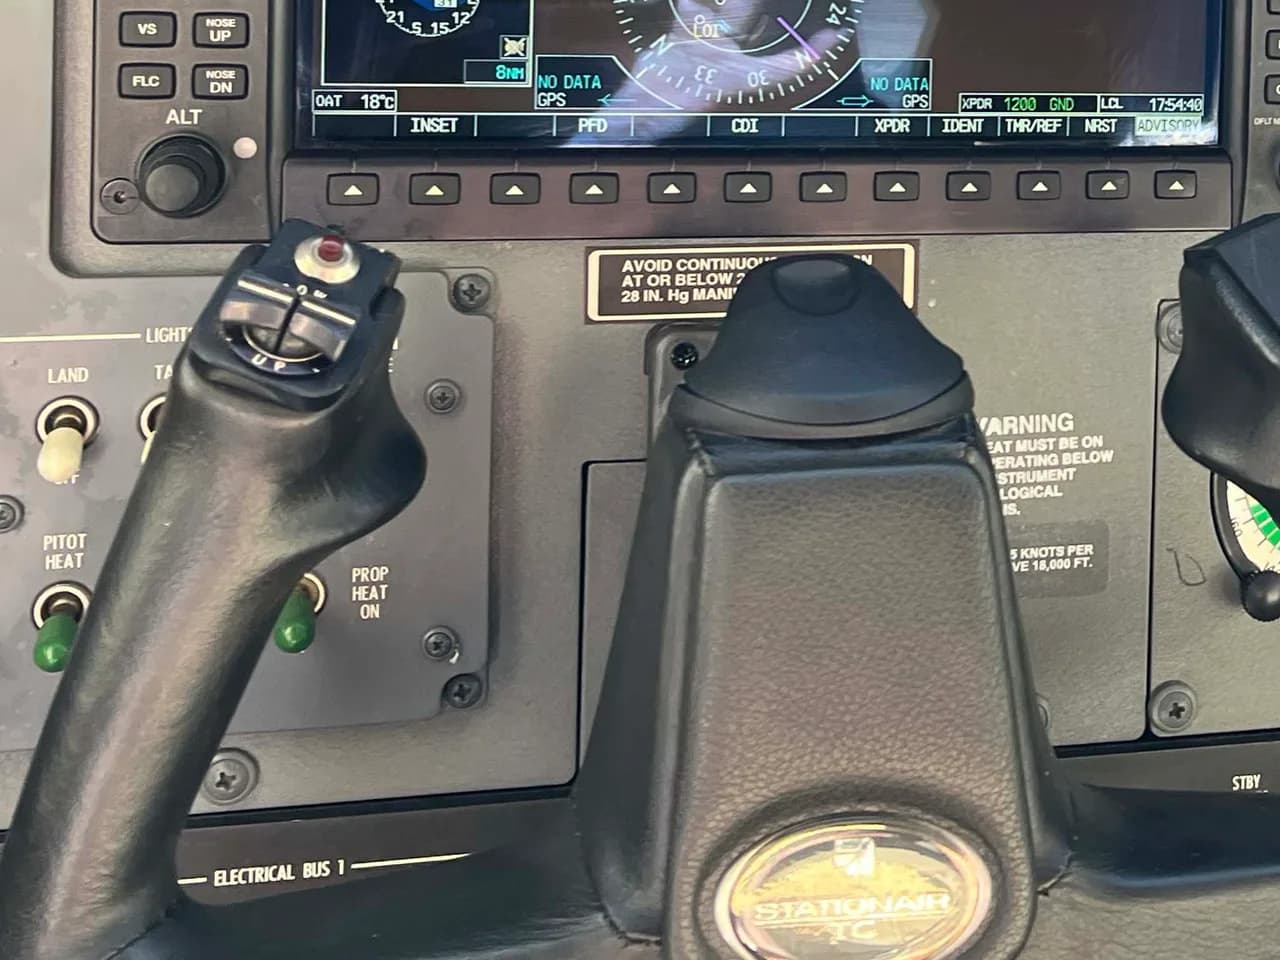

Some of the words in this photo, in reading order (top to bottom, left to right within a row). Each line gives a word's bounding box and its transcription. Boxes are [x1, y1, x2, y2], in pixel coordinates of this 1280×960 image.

[138, 23, 157, 35] VS
[133, 76, 160, 87] FLC
[316, 94, 342, 107] OAT
[361, 94, 394, 110] 18°C
[1004, 97, 1036, 111] 1200
[1049, 98, 1074, 111] GND
[165, 109, 202, 125] ALT
[410, 118, 458, 133] INSET
[578, 118, 607, 134] PFD
[941, 119, 984, 133] IDENT
[1005, 119, 1062, 133] TMR/REF
[1085, 119, 1117, 133] NRST
[622, 258, 672, 273] AVOID
[622, 275, 643, 287] AT
[647, 274, 671, 286] OR
[675, 272, 732, 286] BELOW
[621, 290, 640, 303] 28
[644, 289, 663, 302] IN.
[668, 288, 688, 304] Hg
[48, 367, 89, 384] LAND
[1016, 438, 1056, 452] MUST
[1059, 438, 1078, 449] BE
[1082, 435, 1103, 448] ON
[1062, 450, 1113, 464] BELOW
[43, 533, 87, 551] PITOT
[1021, 546, 1064, 559] KNOTS
[1067, 545, 1093, 556] PER
[45, 553, 84, 570] HEAT
[352, 567, 389, 582] PROP
[352, 585, 388, 601] HEAT
[360, 603, 380, 619] ON
[213, 864, 295, 887] ELECTRICAL
[303, 861, 330, 879] BUS
[337, 859, 344, 875] 1
